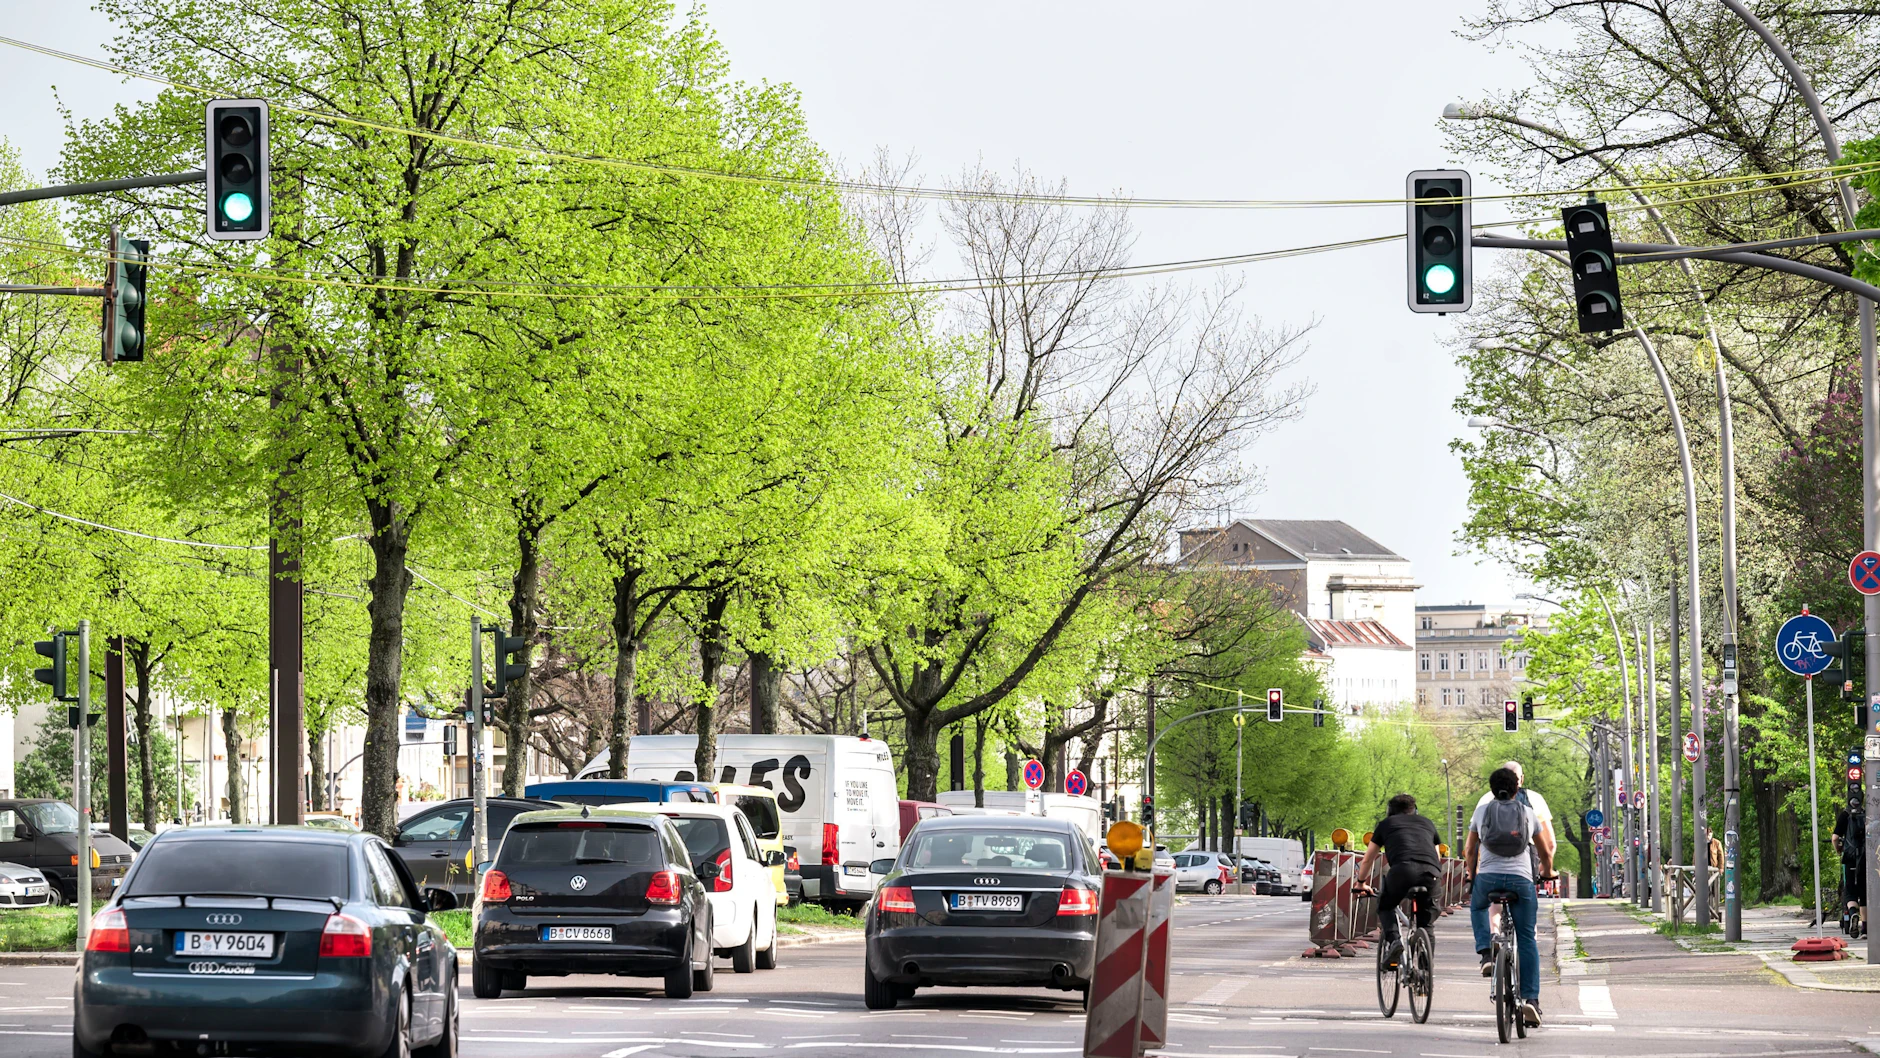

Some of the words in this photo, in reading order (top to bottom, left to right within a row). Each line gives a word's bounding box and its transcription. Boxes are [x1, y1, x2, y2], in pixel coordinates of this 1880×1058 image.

[845, 780, 850, 788] IF
[850, 780, 858, 788] YOU
[859, 781, 868, 789] LIKE
[846, 789, 852, 797] TO
[852, 789, 864, 798] MOVE
[846, 797, 858, 806] MOVE
[959, 896, 966, 906] B
[974, 896, 990, 906] TV
[991, 896, 1020, 907] 8989
[550, 928, 557, 938] B
[565, 928, 581, 938] CV
[582, 928, 611, 939] 8668
[191, 934, 201, 949] B
[213, 935, 223, 950] Y
[226, 935, 265, 951] 9604
[134, 944, 153, 954] A4
